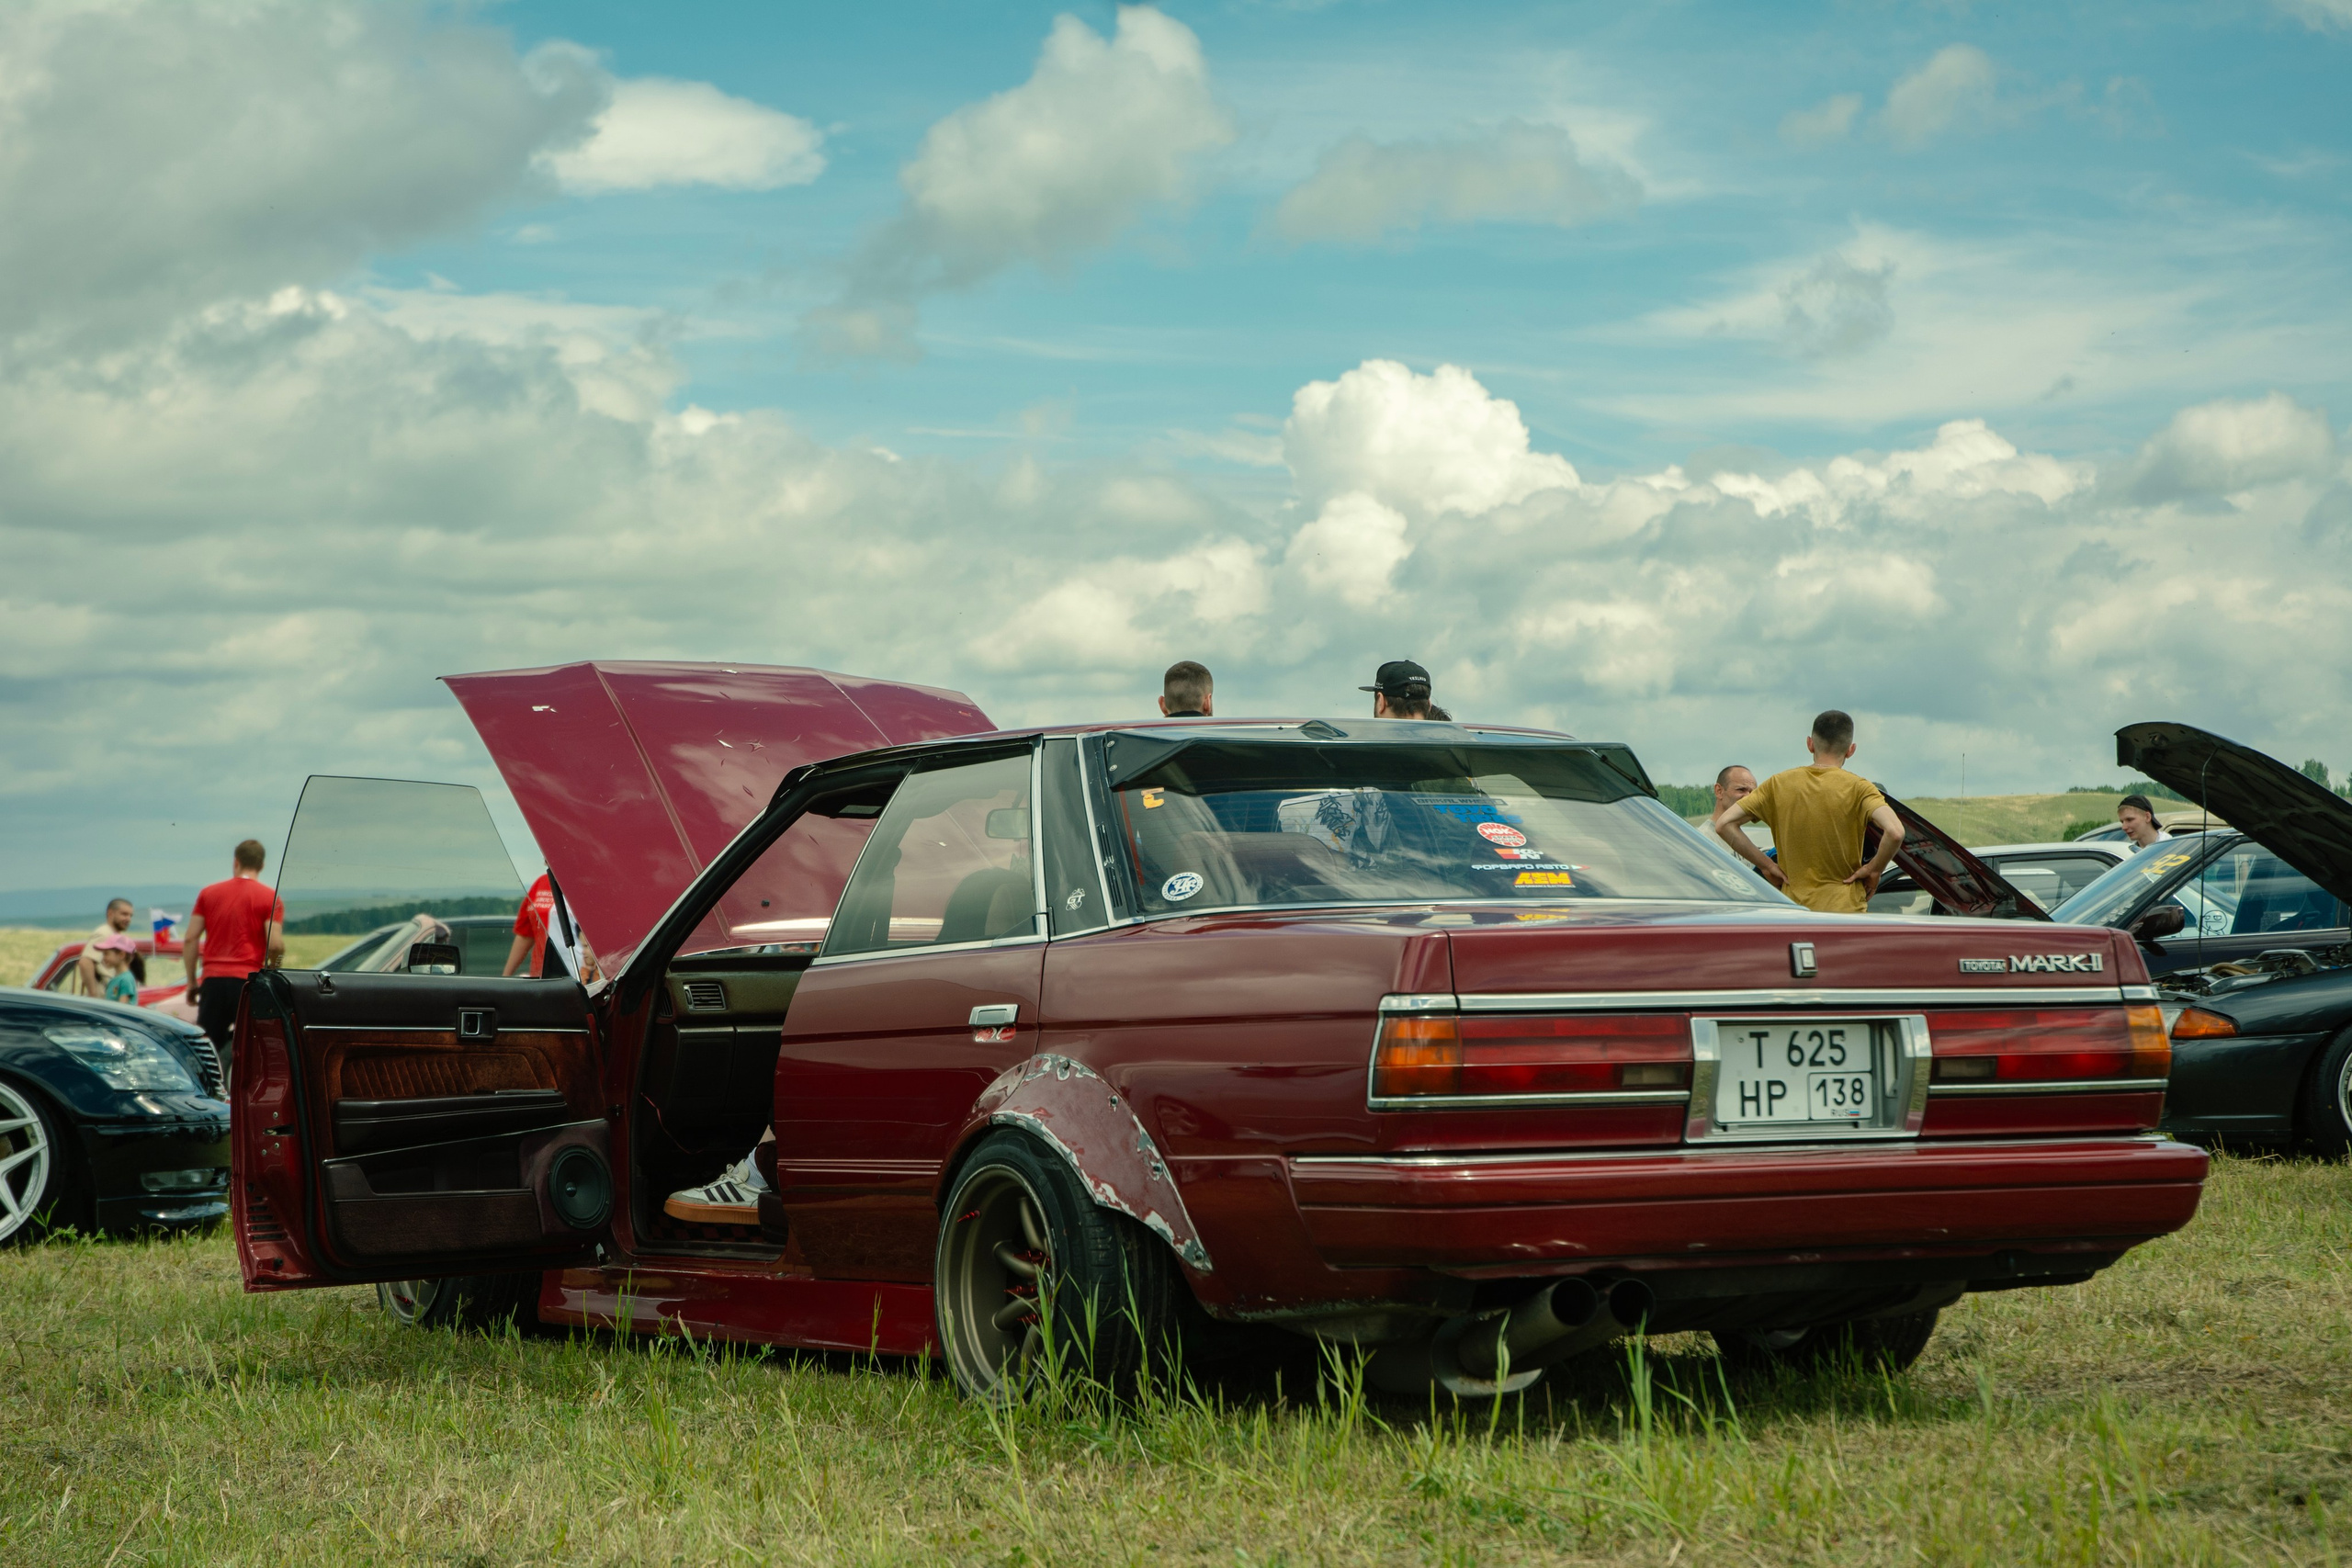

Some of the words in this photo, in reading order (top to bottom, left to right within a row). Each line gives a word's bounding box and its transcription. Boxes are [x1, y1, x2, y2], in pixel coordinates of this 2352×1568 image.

[1434, 805, 1498, 814] TOYO
[1454, 815, 1522, 823] TIRES
[1482, 827, 1514, 835] NGK
[1514, 872, 1573, 885] AEM
[1963, 961, 2005, 971] TOYOTA
[1748, 1031, 1770, 1068] T
[1787, 1030, 1847, 1067] 625
[1739, 1079, 1787, 1117] HP
[1815, 1077, 1865, 1107] 138
[1830, 1109, 1850, 1117] RUS
